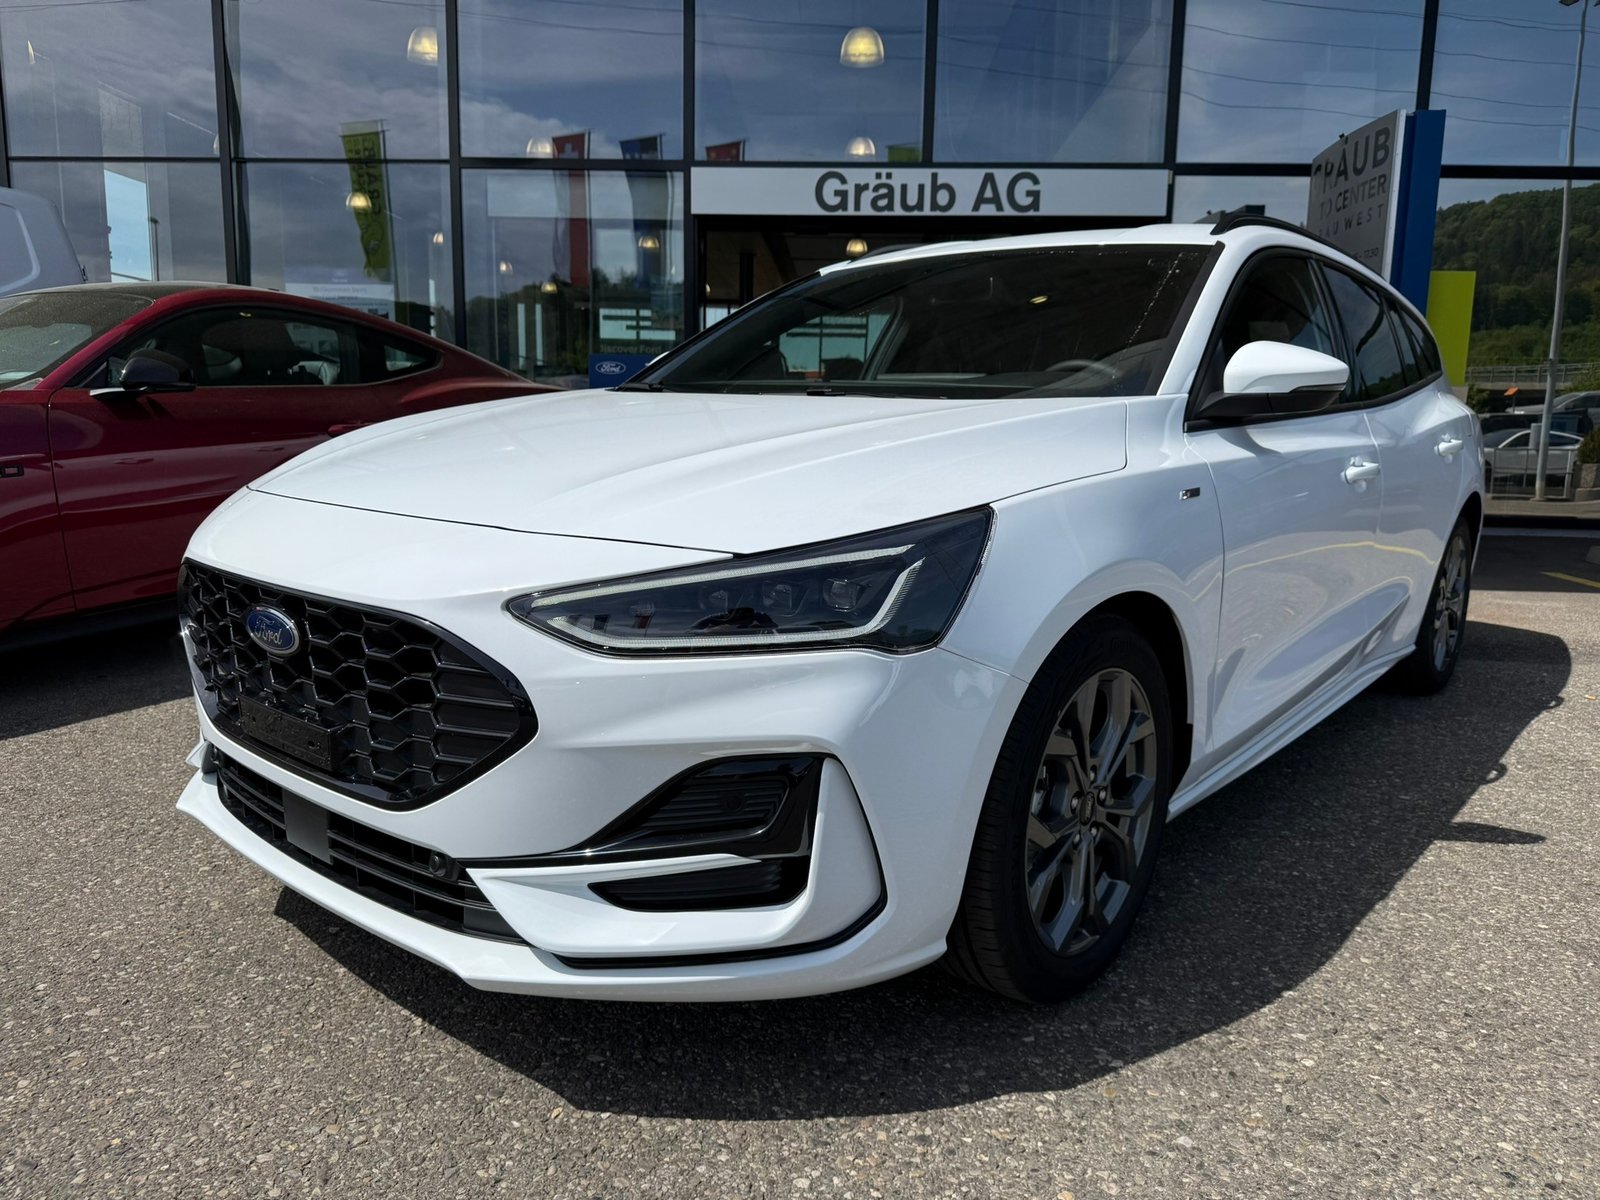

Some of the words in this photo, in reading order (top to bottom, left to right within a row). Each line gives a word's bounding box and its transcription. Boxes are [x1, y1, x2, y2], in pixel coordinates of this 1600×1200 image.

[815, 171, 956, 213] Gräub
[971, 171, 1041, 213] AG
[1335, 174, 1387, 213] CENTER
[1344, 203, 1384, 231] WEST
[598, 362, 623, 374] Ford
[254, 615, 284, 646] Ford
